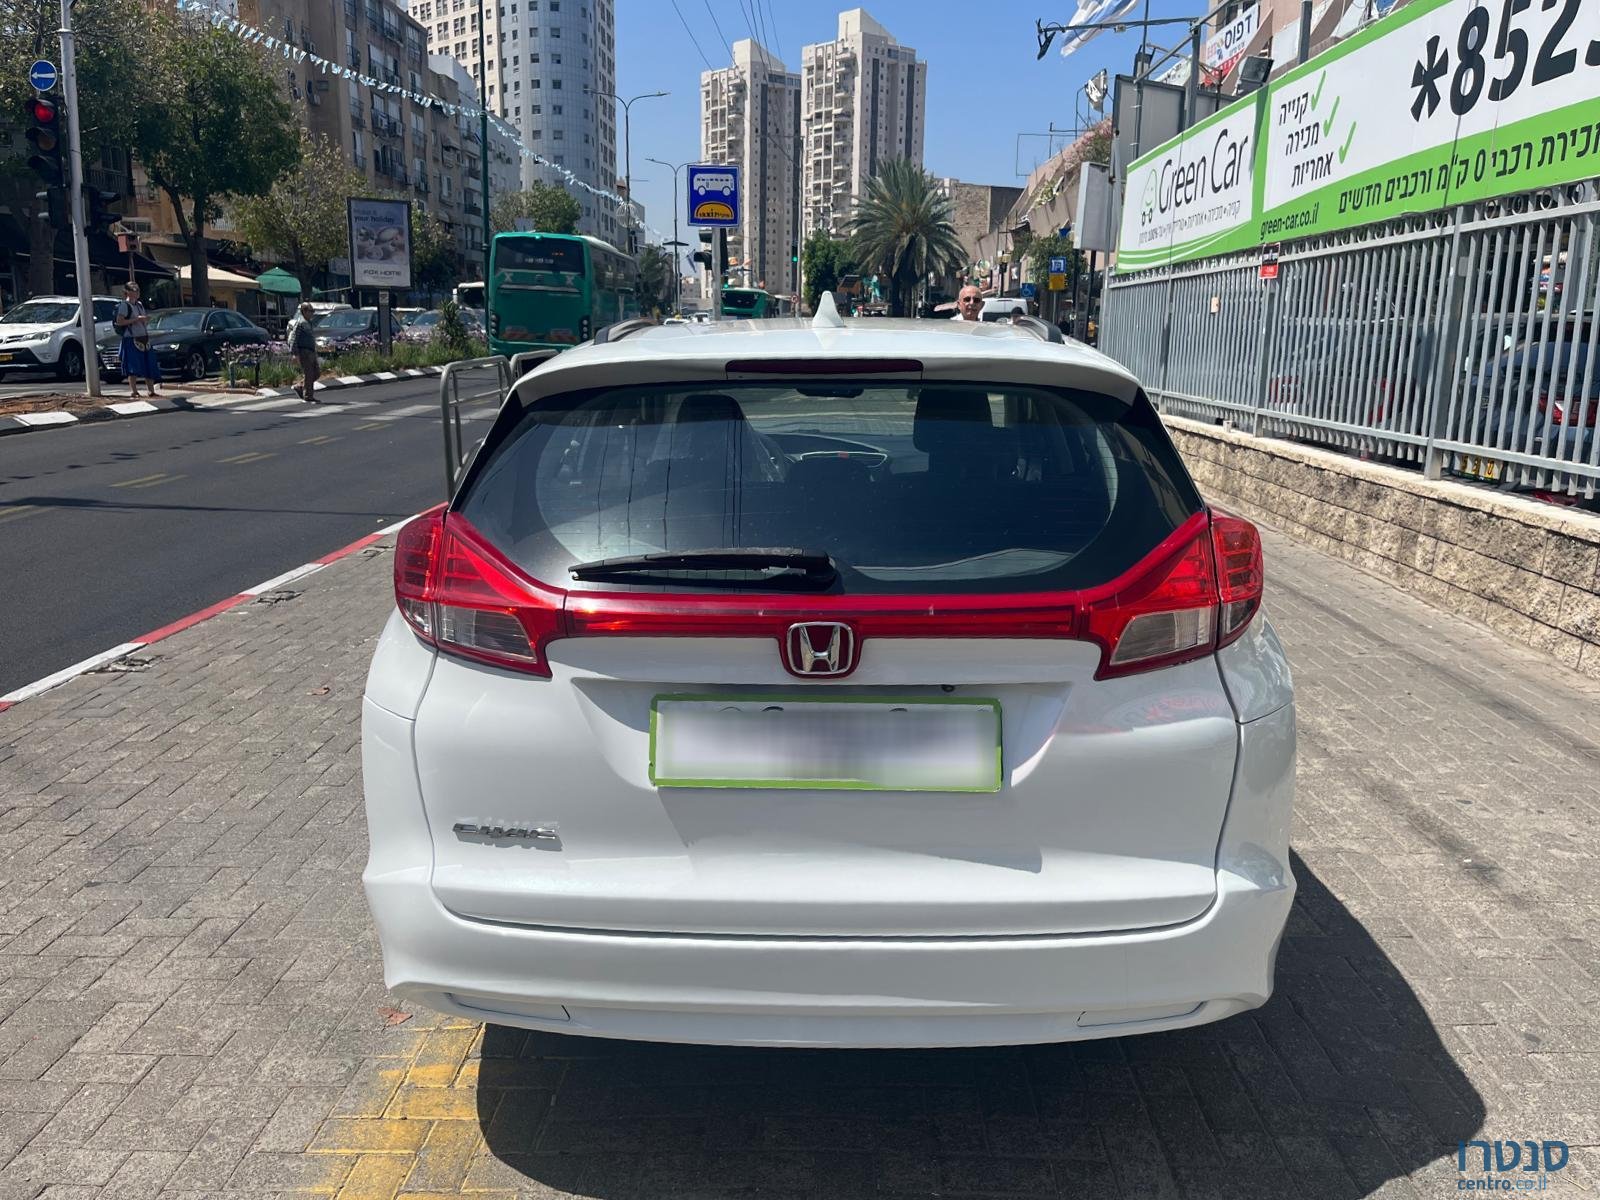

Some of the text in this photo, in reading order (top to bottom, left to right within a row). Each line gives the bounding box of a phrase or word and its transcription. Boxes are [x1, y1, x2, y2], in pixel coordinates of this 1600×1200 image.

[1224, 14, 1253, 50] דפוס
[1410, 0, 1600, 123] 852
[1279, 91, 1309, 126] קנייה
[1285, 121, 1320, 156] מכירה
[1158, 128, 1249, 214] Green Car
[1291, 152, 1334, 188] אחריות
[1474, 148, 1486, 183] 0
[1491, 141, 1533, 178] רכבי
[1338, 182, 1382, 214] חדשים
[1384, 168, 1433, 203] ורכבים
[1260, 201, 1320, 241] green-car.co.il
